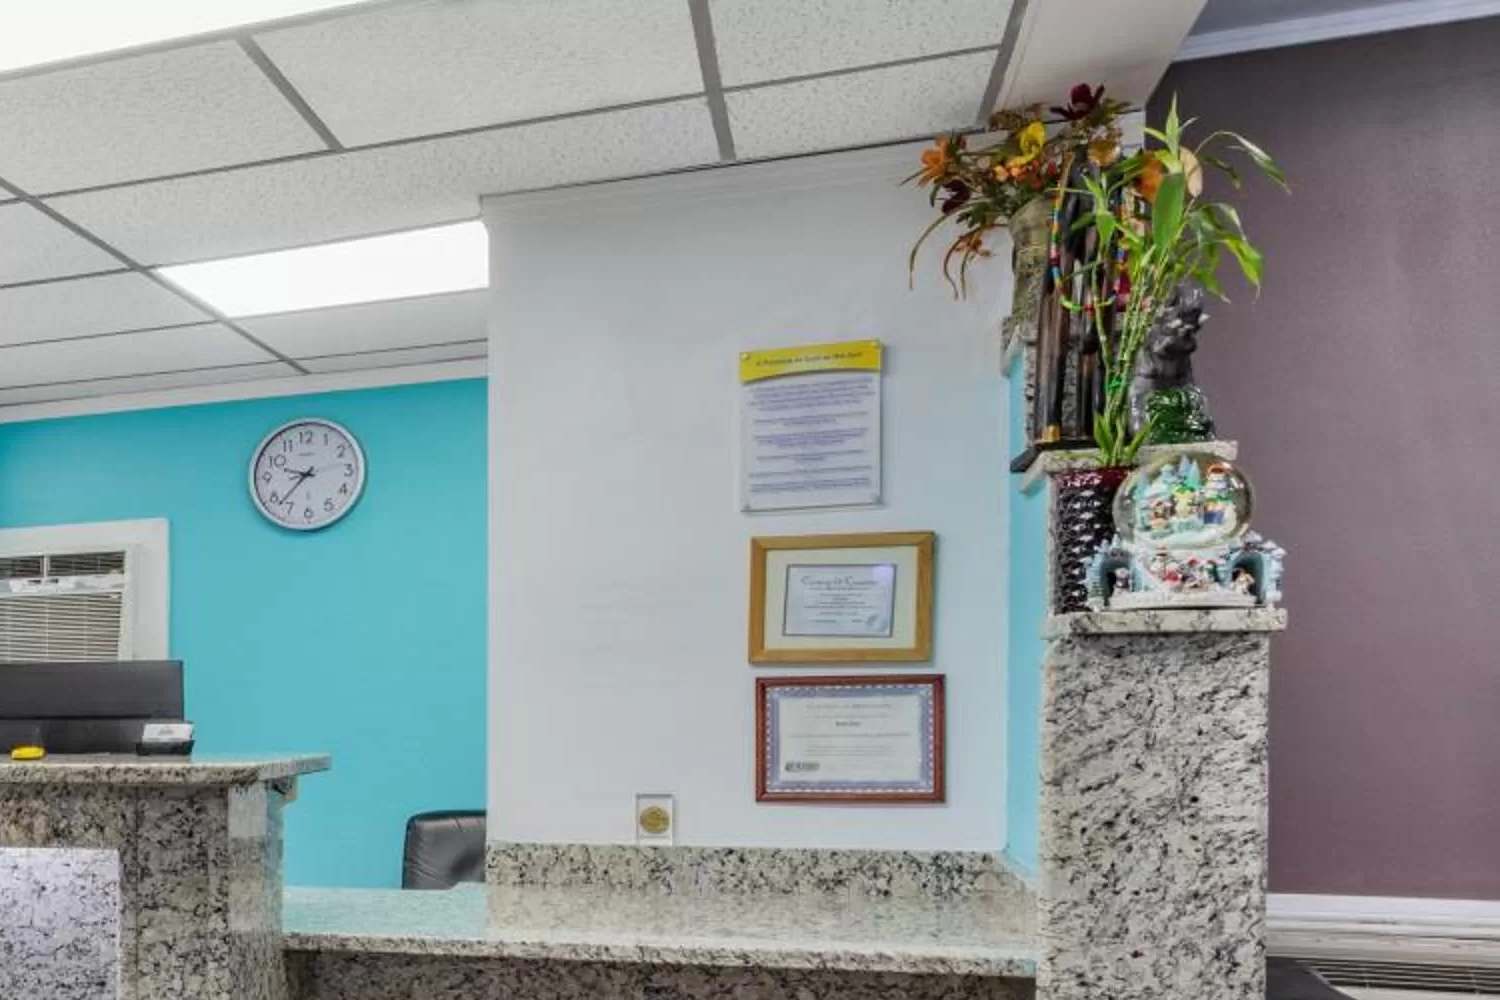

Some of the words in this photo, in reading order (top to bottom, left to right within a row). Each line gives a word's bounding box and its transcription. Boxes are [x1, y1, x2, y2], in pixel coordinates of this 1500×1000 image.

[299, 431, 313, 444] 12
[323, 433, 329, 446] 1
[283, 440, 294, 453] 11
[337, 444, 346, 458] 2
[268, 454, 287, 468] 10
[344, 463, 353, 477] 3
[262, 471, 272, 483] 9
[339, 483, 348, 495] 4
[286, 501, 294, 514] 7
[324, 498, 334, 511] 5
[304, 508, 313, 519] 6
